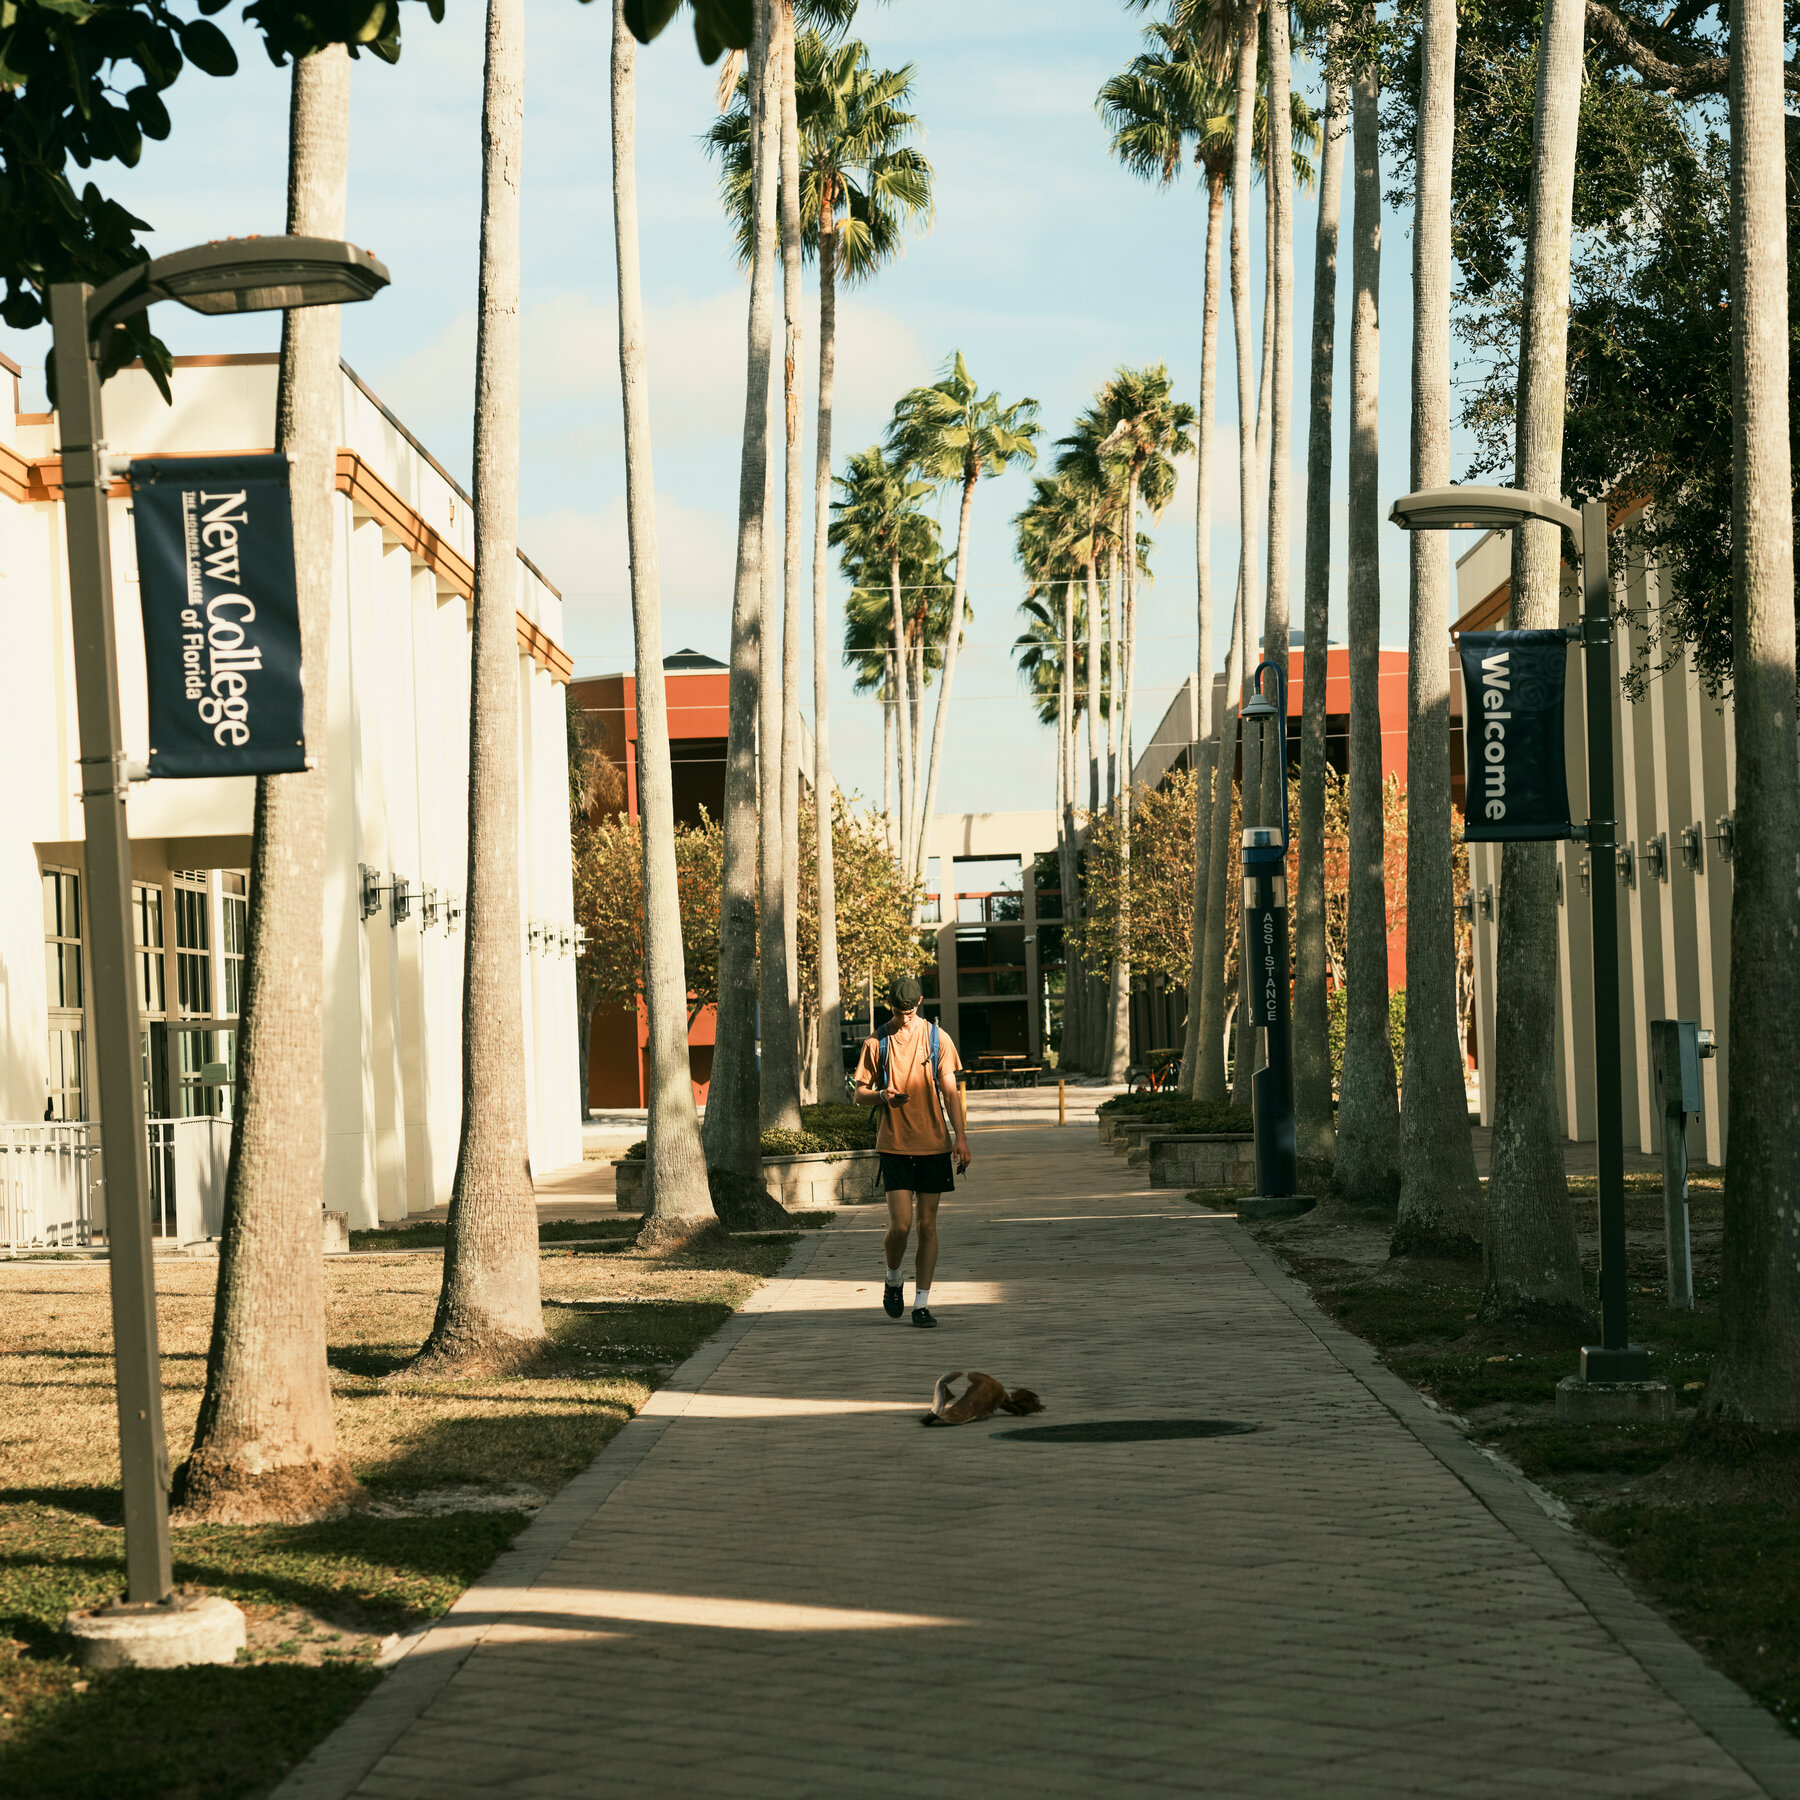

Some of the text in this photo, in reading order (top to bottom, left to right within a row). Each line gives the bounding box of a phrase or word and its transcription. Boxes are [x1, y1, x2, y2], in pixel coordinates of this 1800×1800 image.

[186, 491, 203, 605] THE HONORS COLLEGE
[180, 609, 206, 699] of Florida
[198, 489, 263, 746] New College
[1481, 652, 1512, 820] Welcome
[1263, 912, 1277, 1021] ASSISTANCE
